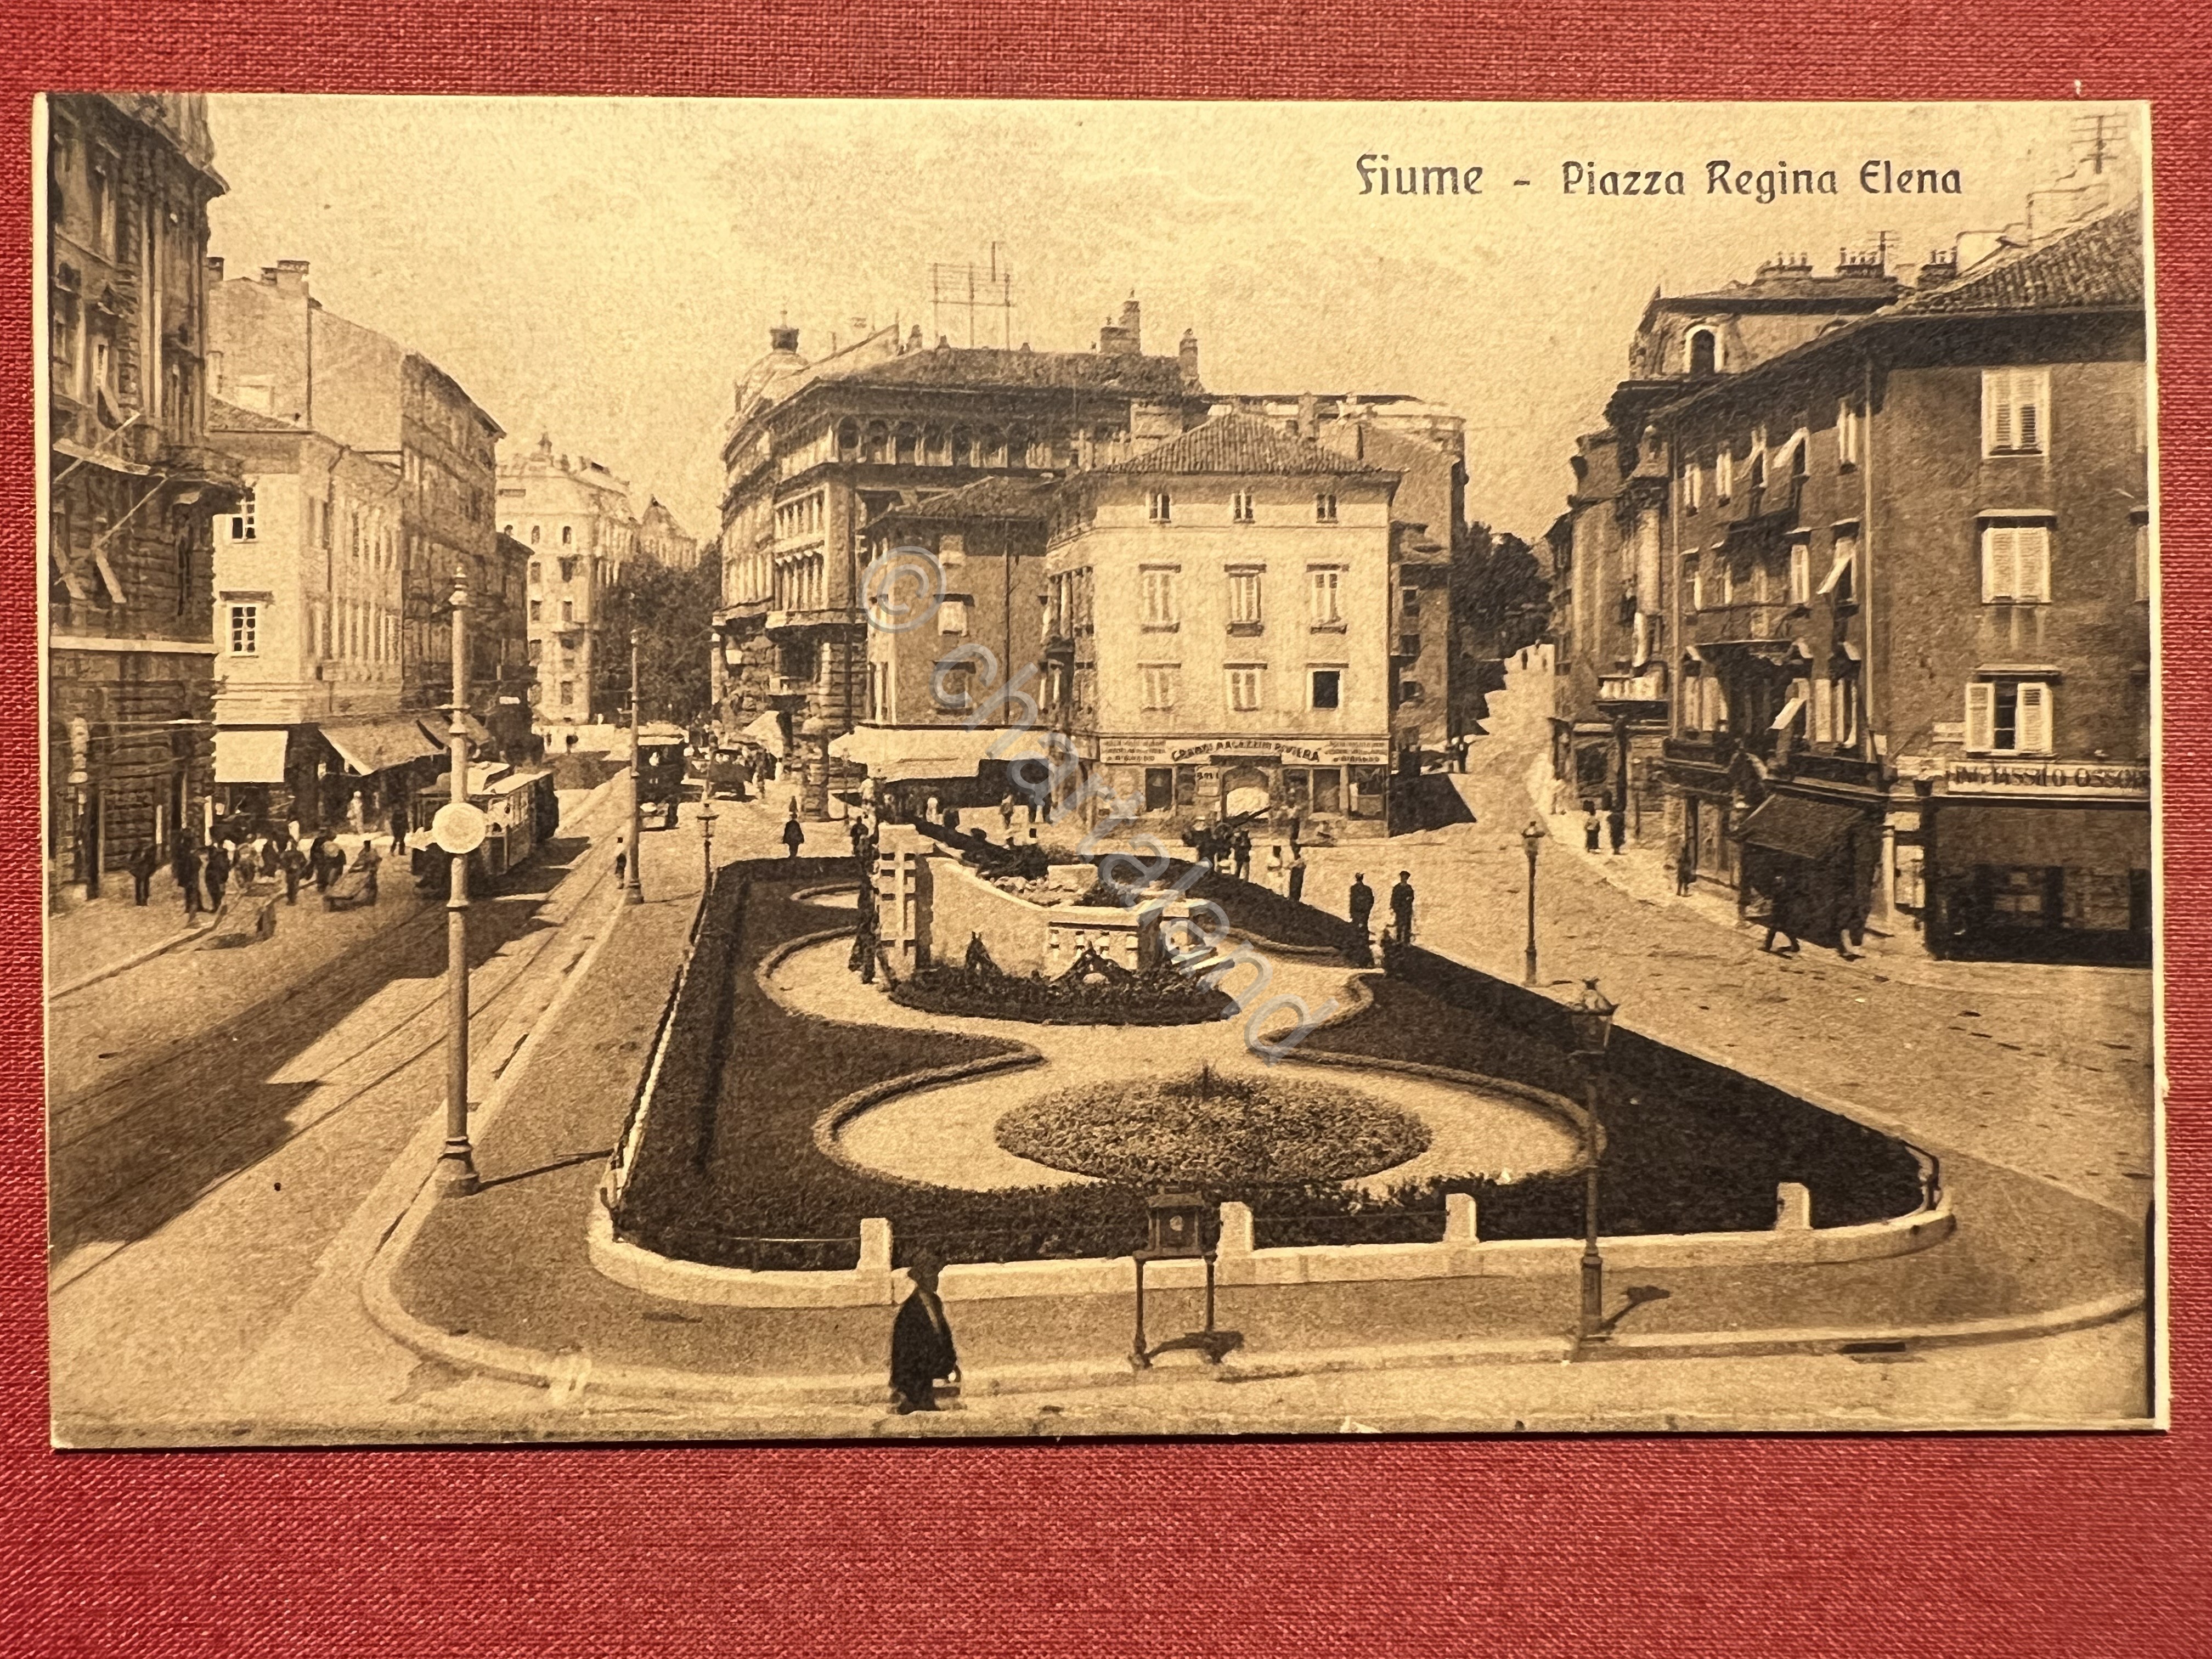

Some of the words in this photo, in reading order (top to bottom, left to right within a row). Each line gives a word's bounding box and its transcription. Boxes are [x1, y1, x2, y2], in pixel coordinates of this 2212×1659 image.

[1356, 153, 1483, 195] Fiume
[1561, 160, 1685, 196] Piazza
[1705, 160, 1838, 204] Regina
[1859, 160, 1962, 194] Elena
